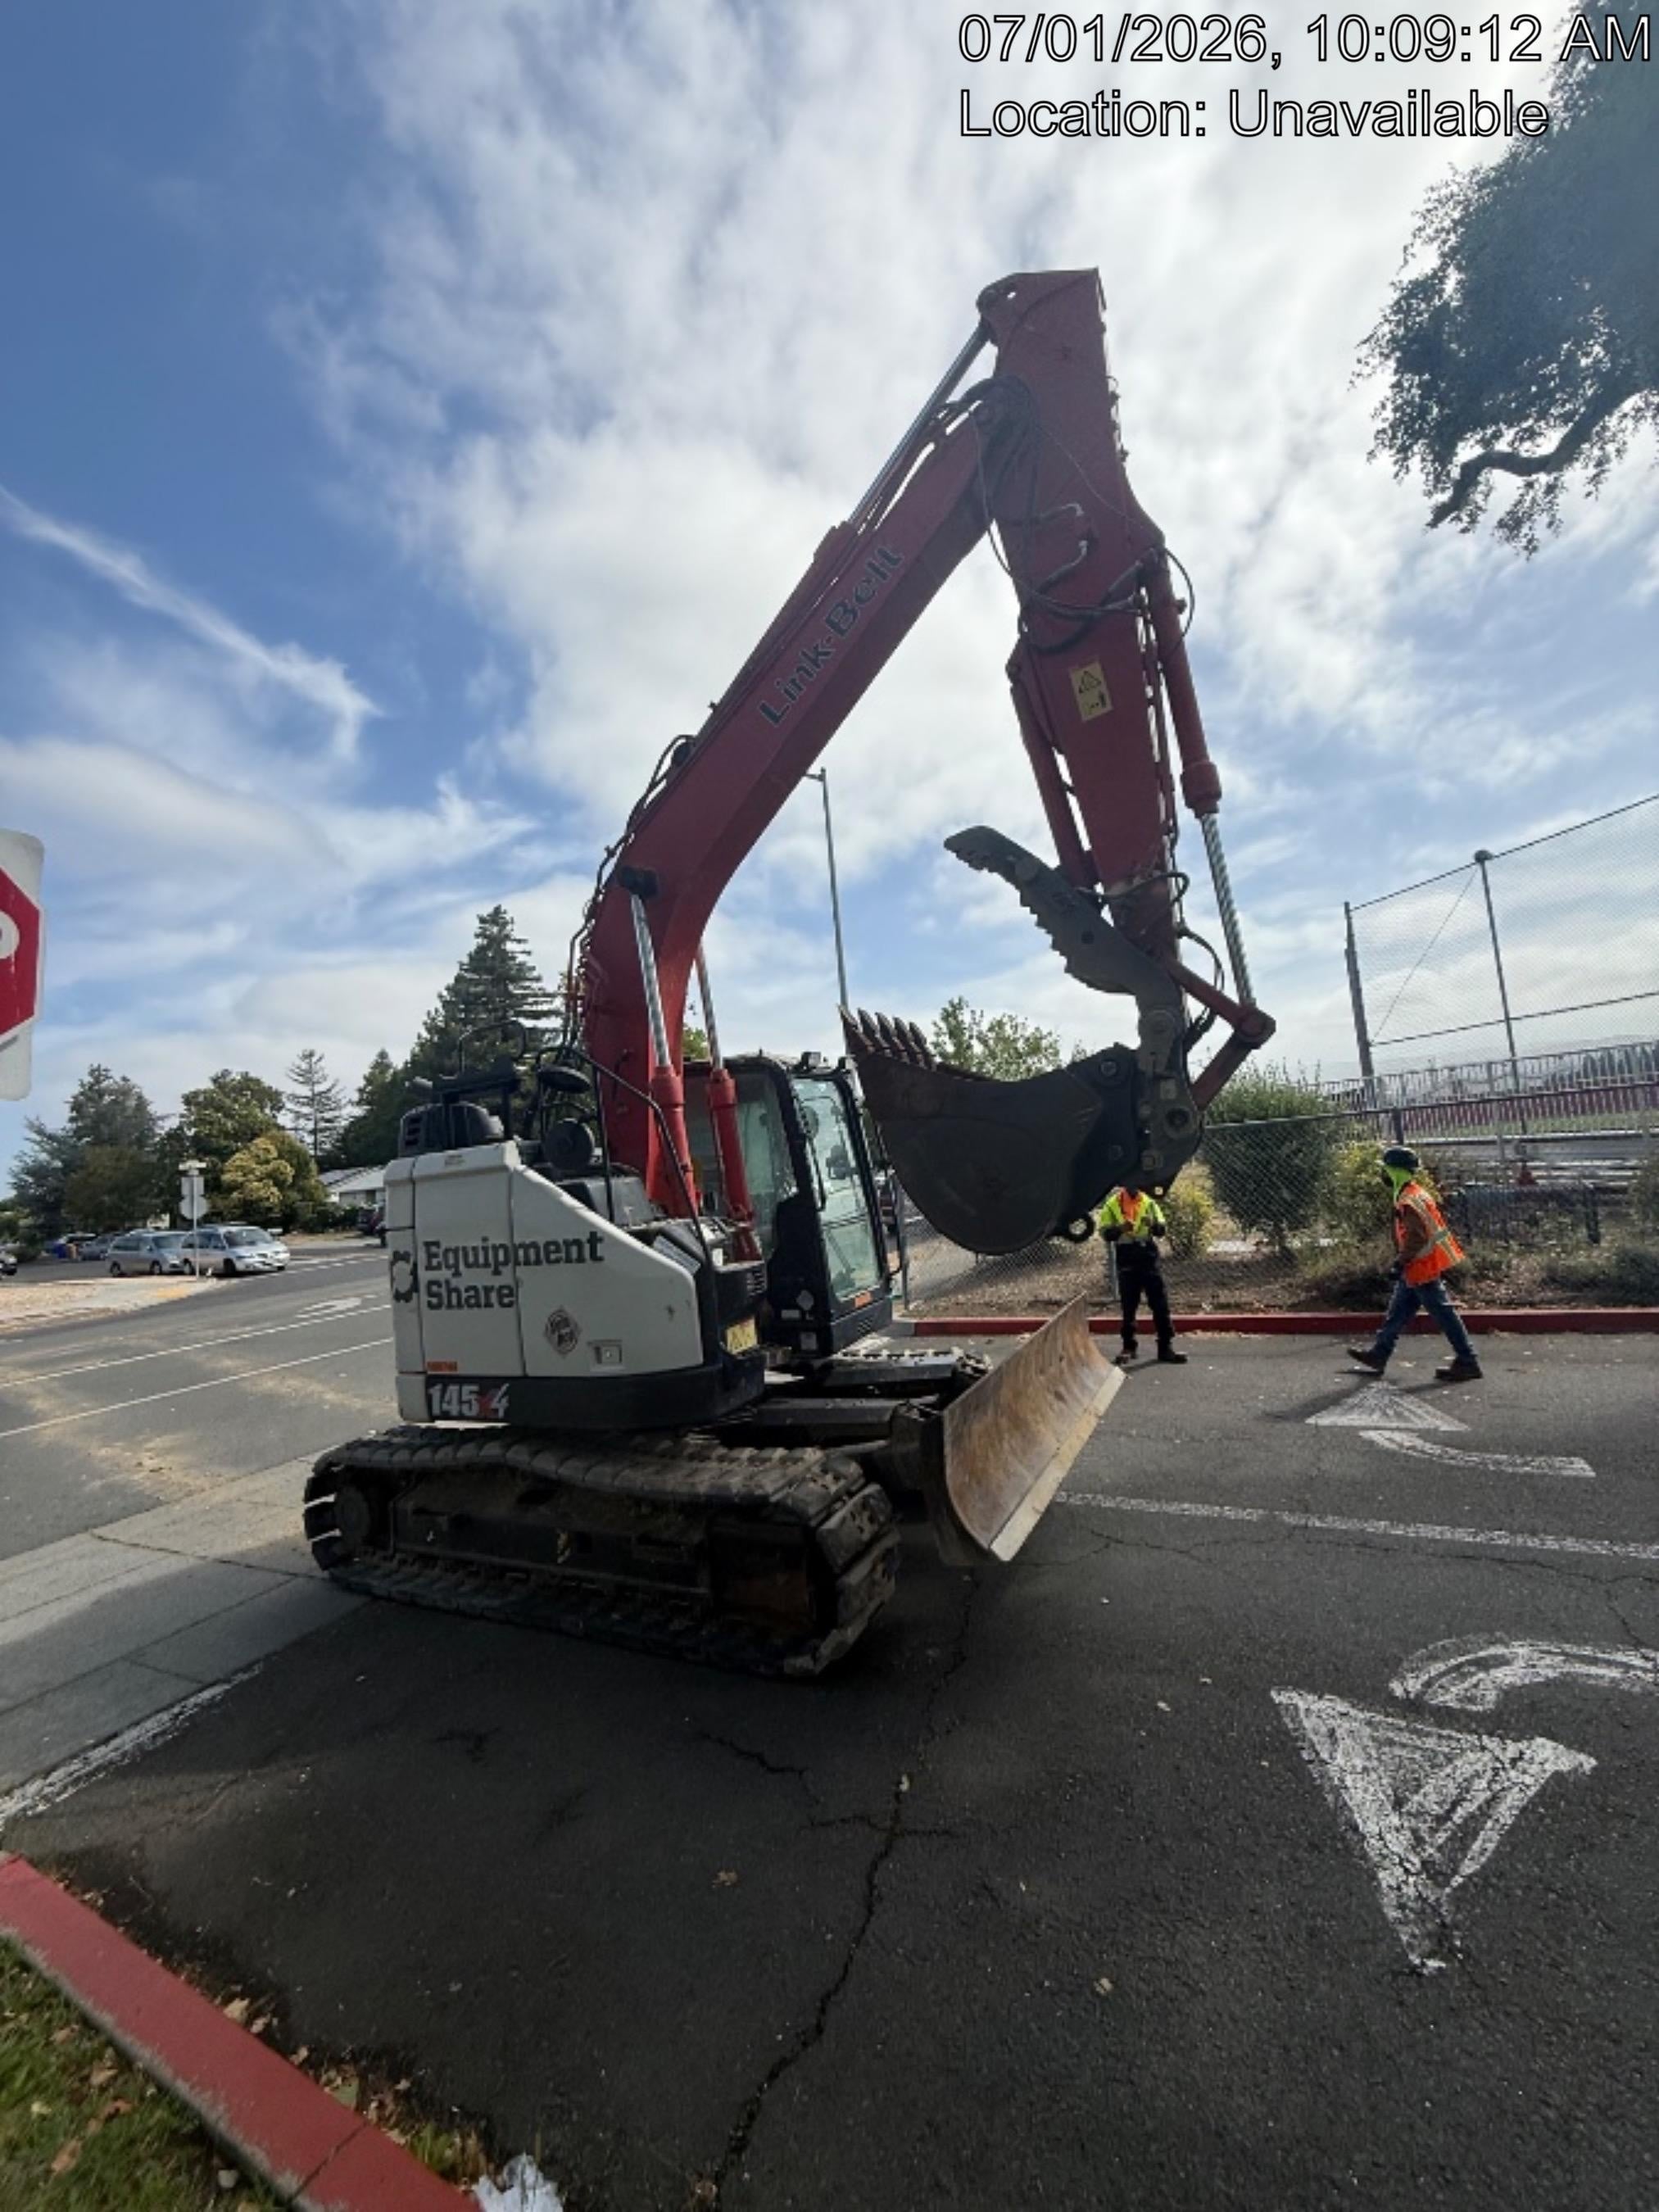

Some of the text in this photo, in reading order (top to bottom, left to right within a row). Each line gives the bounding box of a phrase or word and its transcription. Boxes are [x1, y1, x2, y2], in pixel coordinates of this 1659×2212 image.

[759, 546, 904, 727] Link-Belt
[423, 1231, 605, 1277] Equipment
[426, 1280, 514, 1310] Share
